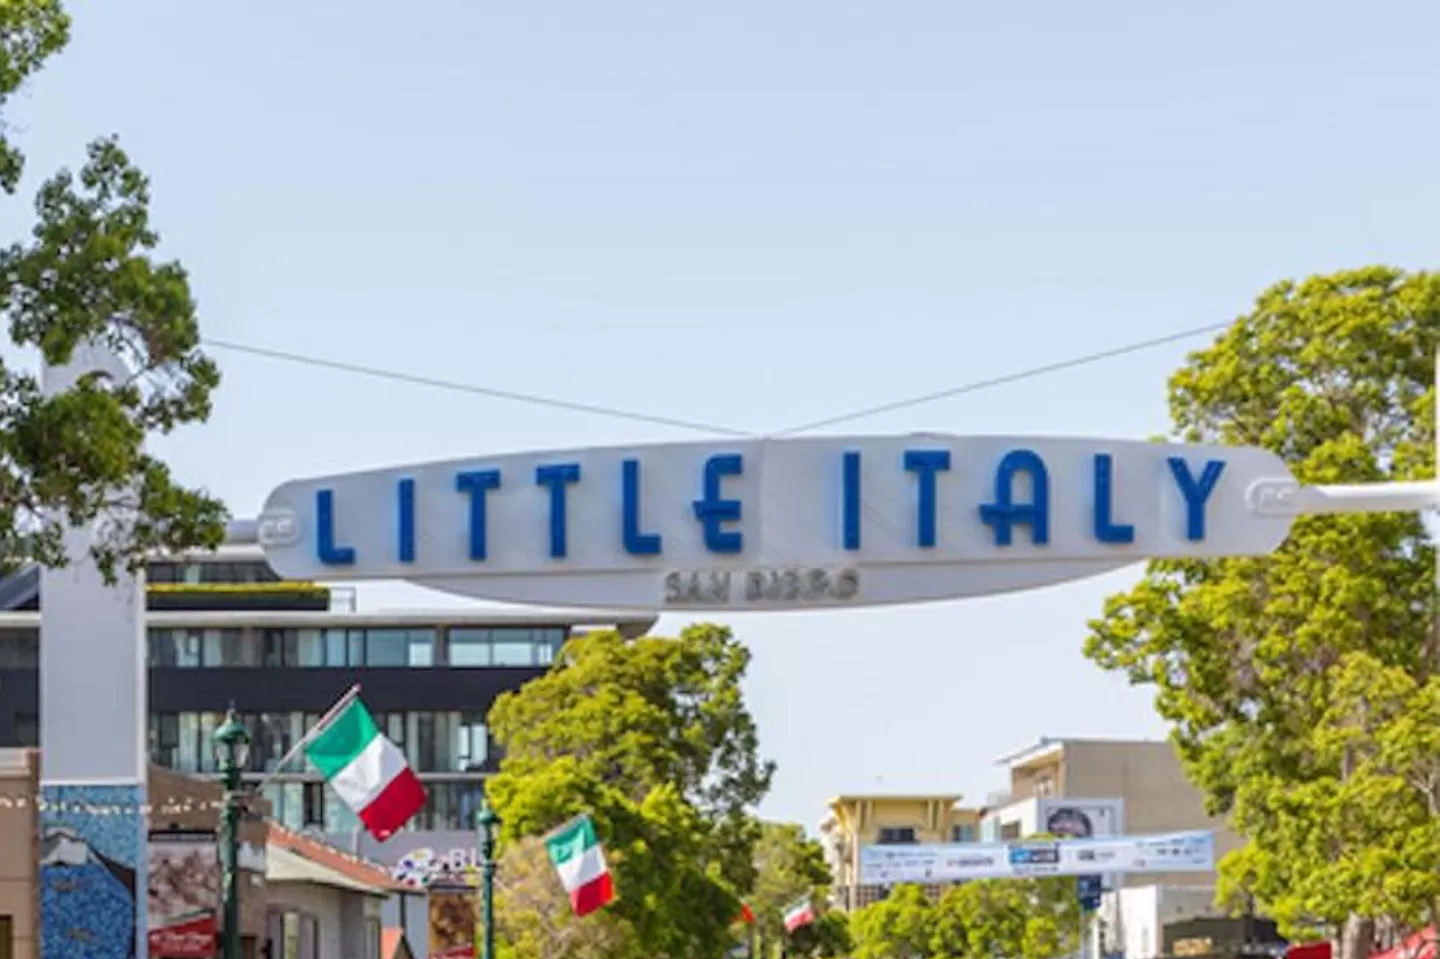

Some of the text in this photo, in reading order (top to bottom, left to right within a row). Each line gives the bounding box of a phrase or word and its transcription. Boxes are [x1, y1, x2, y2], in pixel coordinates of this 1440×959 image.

[308, 446, 1226, 564] LITTLE ITALY
[664, 567, 861, 603] SAN DIEGO
